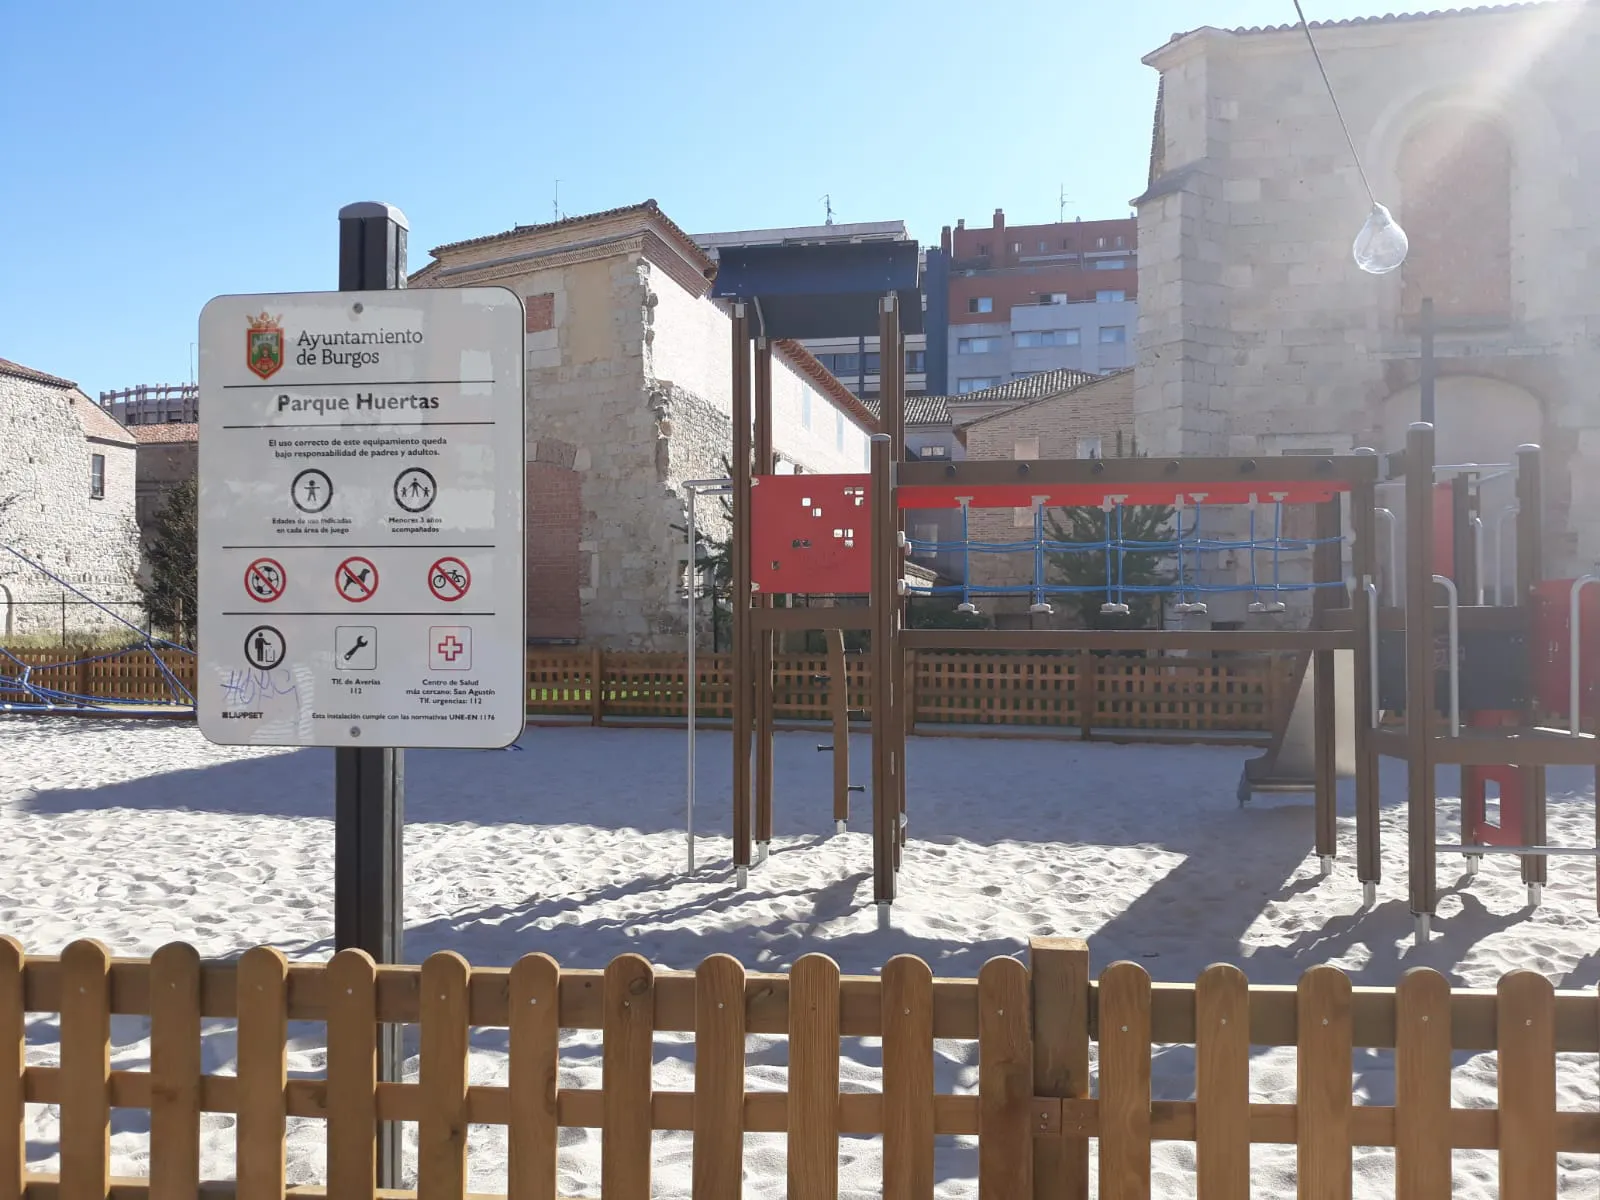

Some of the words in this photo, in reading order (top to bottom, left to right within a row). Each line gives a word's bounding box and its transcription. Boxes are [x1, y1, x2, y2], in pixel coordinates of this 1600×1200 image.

[297, 328, 423, 350] Ayuntamiento
[296, 350, 317, 365] de
[322, 349, 380, 368] Burgos
[277, 394, 350, 416] Parque
[356, 392, 440, 411] Huertas
[268, 439, 277, 447] El
[294, 439, 330, 447] correcto
[362, 438, 420, 448] equipamiento
[421, 437, 447, 447] queda
[275, 450, 292, 459] bajo
[294, 449, 357, 459] responsabilidad
[359, 449, 369, 457] de
[371, 449, 399, 459] padres
[407, 448, 440, 457] adultos.
[272, 517, 296, 525] Edades
[286, 526, 302, 534] cada
[320, 526, 329, 534] de
[330, 527, 350, 535] juego
[453, 688, 467, 696] San
[470, 697, 482, 705] 112
